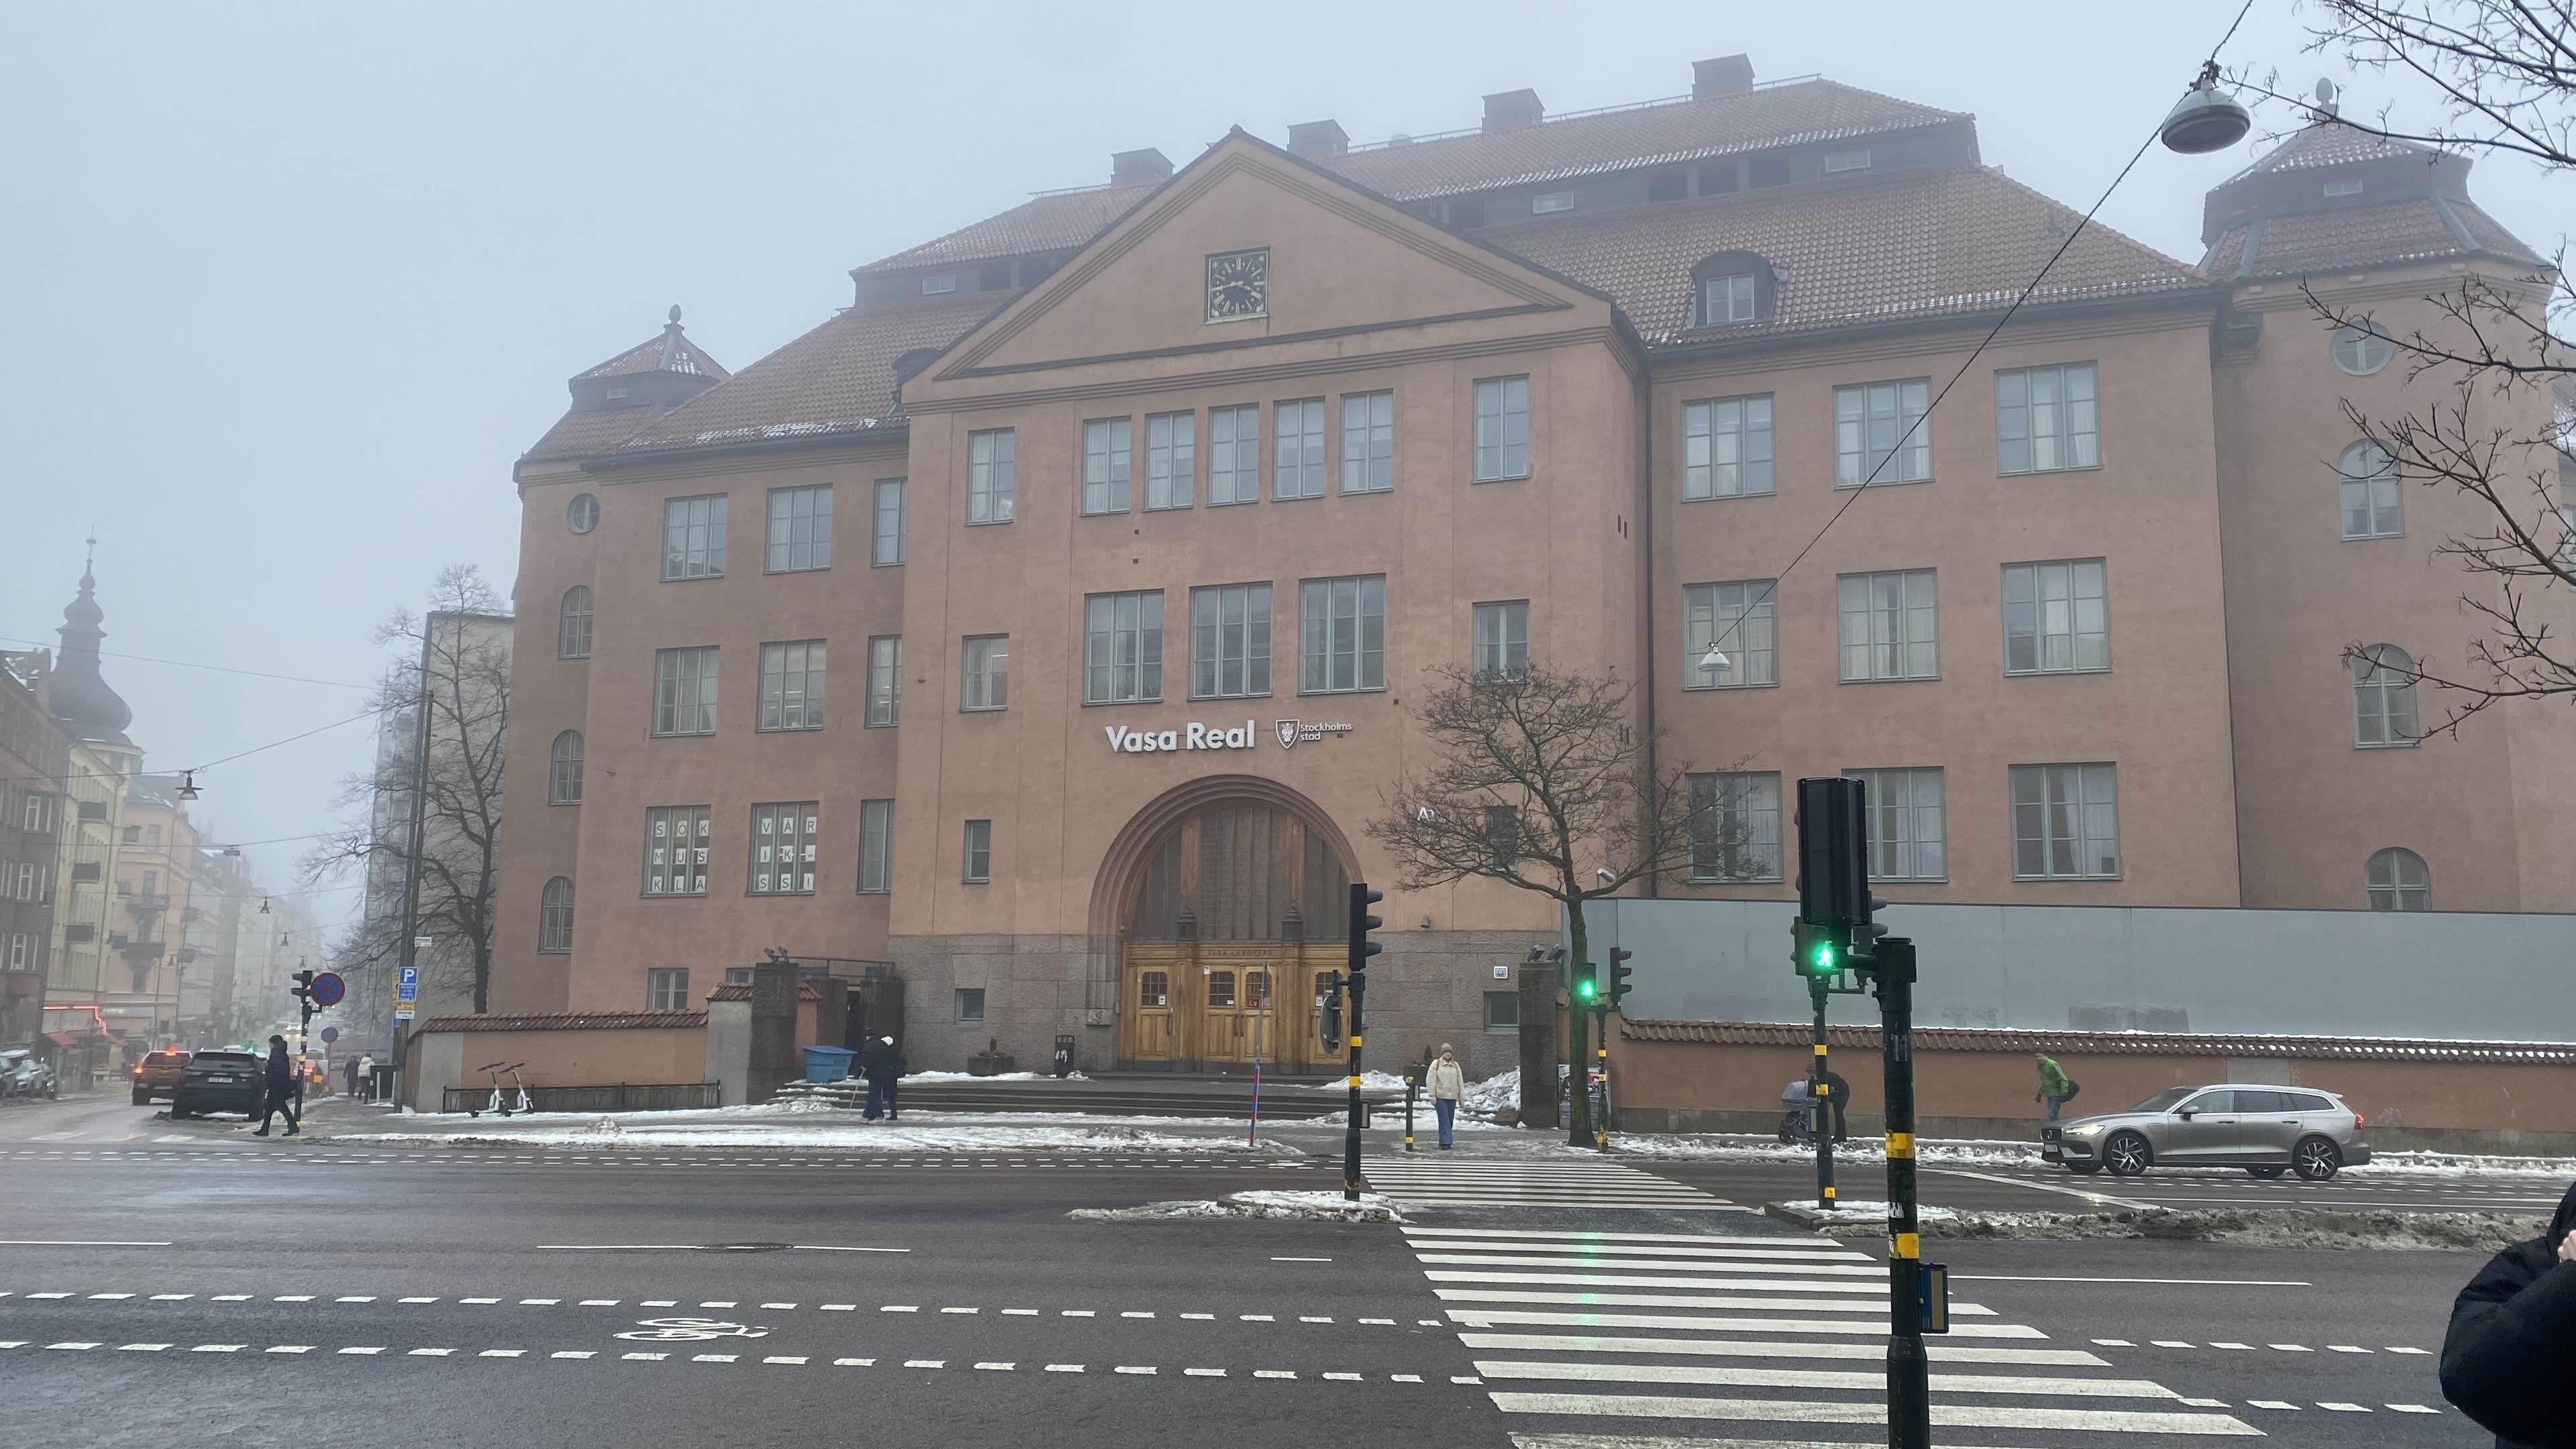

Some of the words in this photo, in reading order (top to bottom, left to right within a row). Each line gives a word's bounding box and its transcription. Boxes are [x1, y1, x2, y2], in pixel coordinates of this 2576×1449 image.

[1300, 722, 1352, 732] Stockholms
[1105, 725, 1177, 753] Vasa
[1187, 719, 1255, 750] Real
[1300, 732, 1321, 741] stad
[403, 969, 415, 983] P
